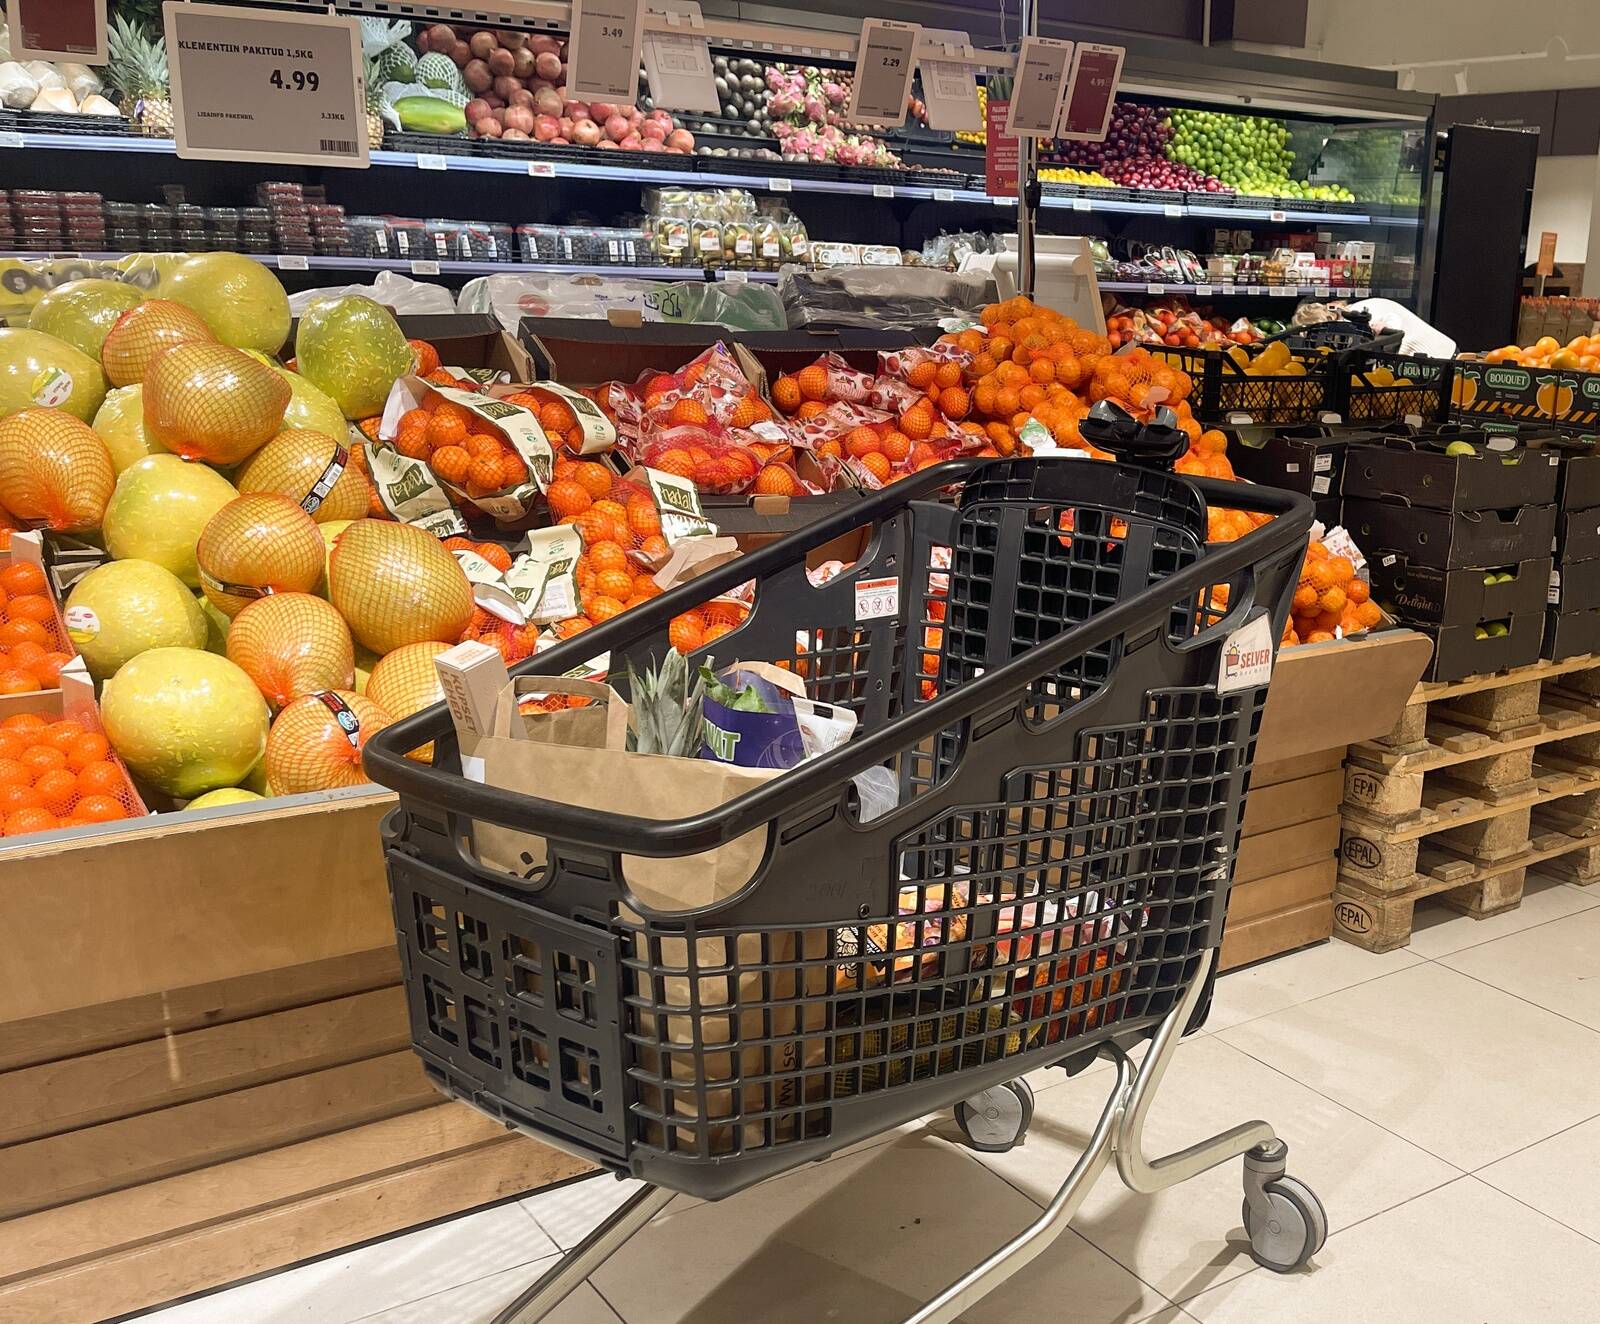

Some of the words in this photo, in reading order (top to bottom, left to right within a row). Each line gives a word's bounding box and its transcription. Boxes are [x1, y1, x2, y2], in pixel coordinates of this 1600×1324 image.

[602, 27, 623, 38] 3.49
[178, 40, 240, 52] KLEMENTIIN
[242, 45, 284, 56] PAKITUD
[286, 48, 314, 59] 1,5KG
[882, 57, 900, 67] 2.29
[269, 69, 320, 92] 4.99
[1490, 373, 1527, 386] BOUQUET
[389, 469, 426, 504] nadal
[660, 486, 692, 511] nadal
[1240, 648, 1270, 669] SELVER
[1348, 842, 1376, 865] EPAL
[1340, 906, 1367, 930] EPAL
